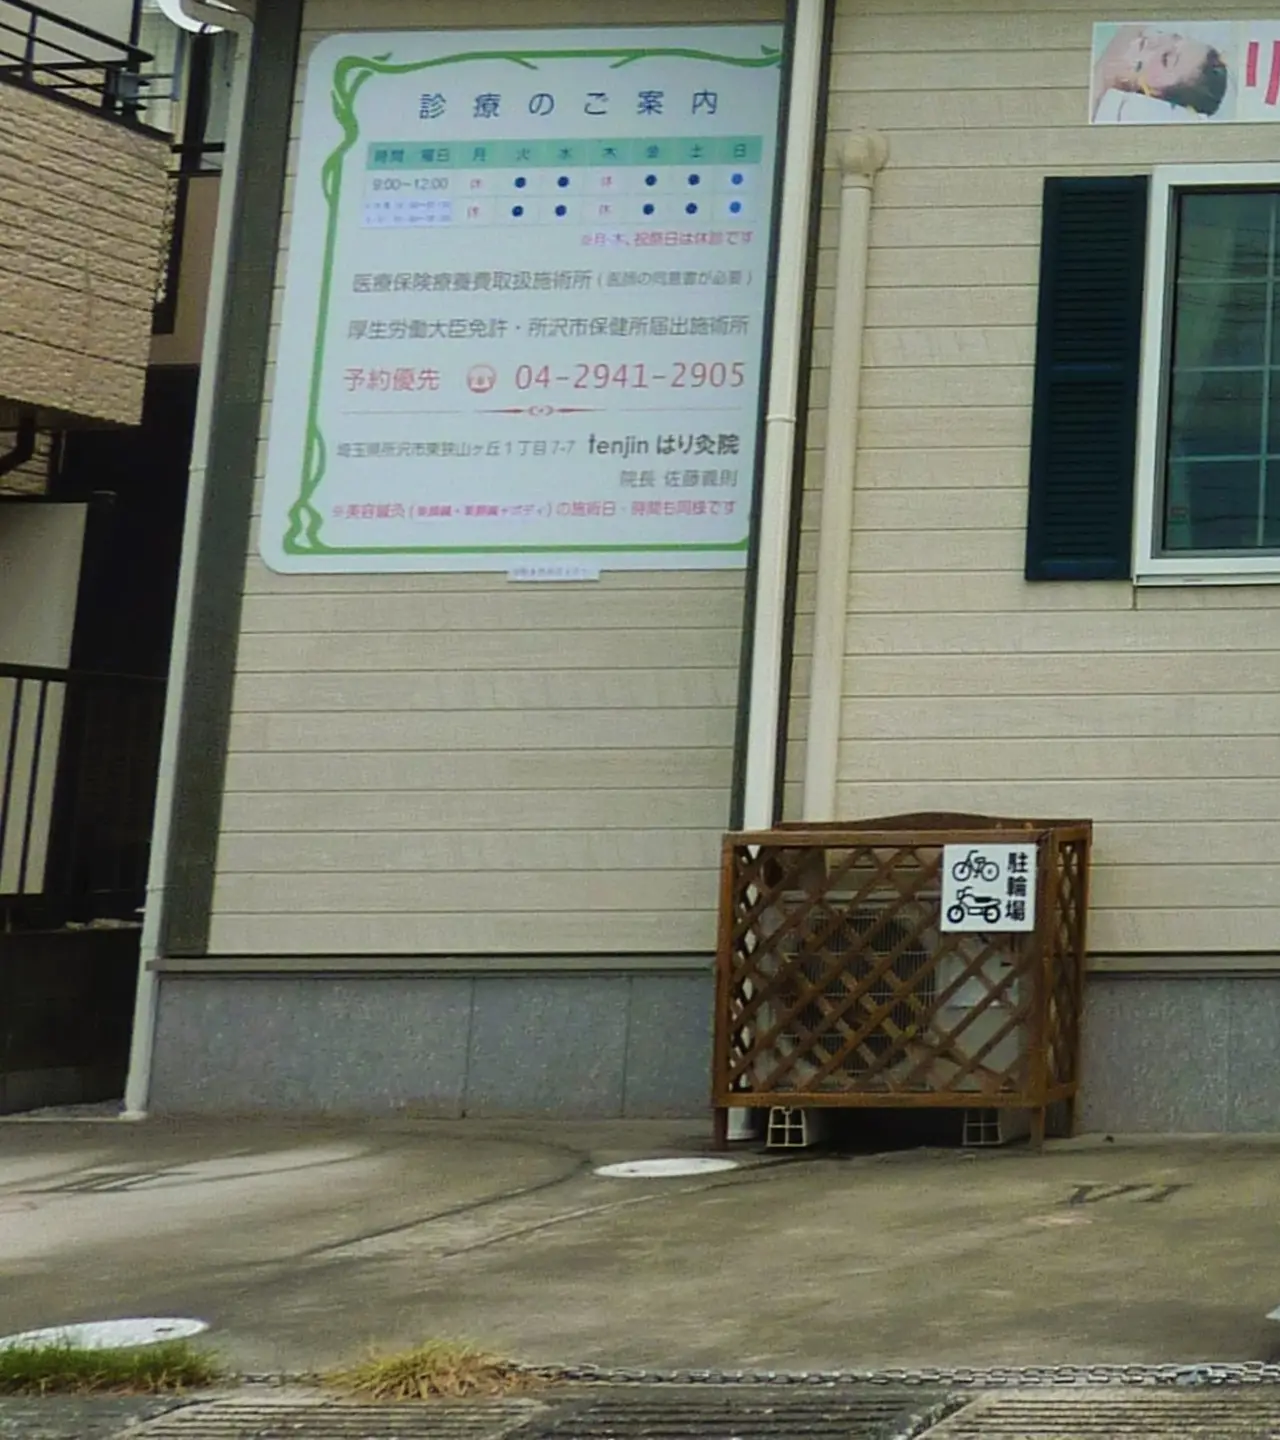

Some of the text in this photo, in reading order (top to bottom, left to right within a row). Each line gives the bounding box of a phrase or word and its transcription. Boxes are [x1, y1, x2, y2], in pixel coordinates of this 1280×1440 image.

[418, 90, 719, 120] 診療のご案内
[343, 362, 747, 392] 予約優先 04-2941-2905
[656, 434, 740, 456] はり灸院
[1004, 852, 1029, 923] 駐輪場
